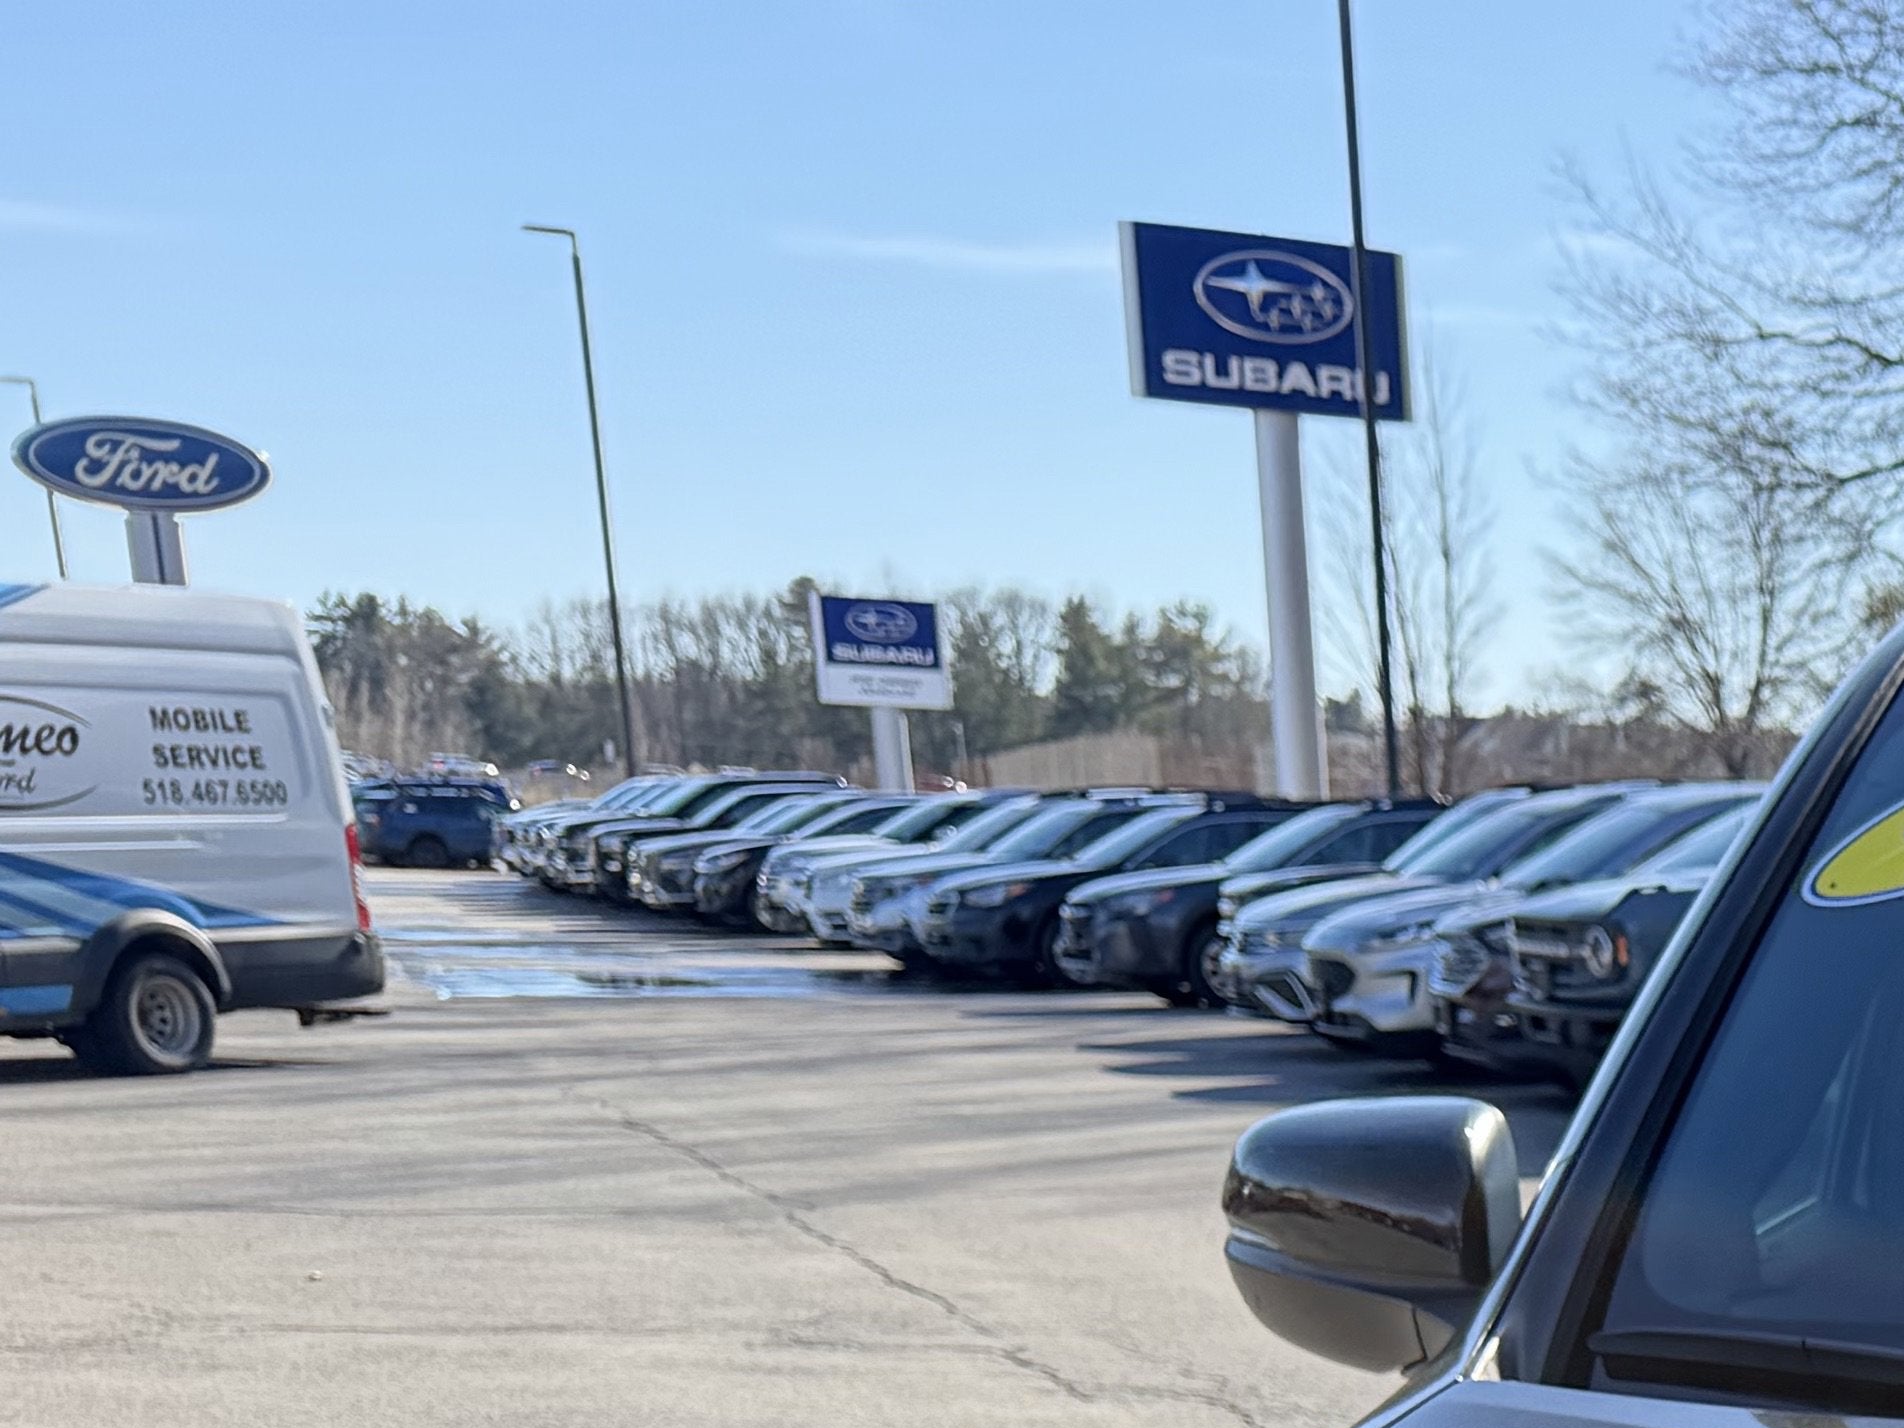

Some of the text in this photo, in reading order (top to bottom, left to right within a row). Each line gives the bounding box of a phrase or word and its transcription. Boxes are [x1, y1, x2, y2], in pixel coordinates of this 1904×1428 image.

[1161, 348, 1390, 406] SUBARU
[74, 431, 220, 494] Ford
[148, 705, 252, 734] MOBILE
[152, 743, 266, 770] SERVICE
